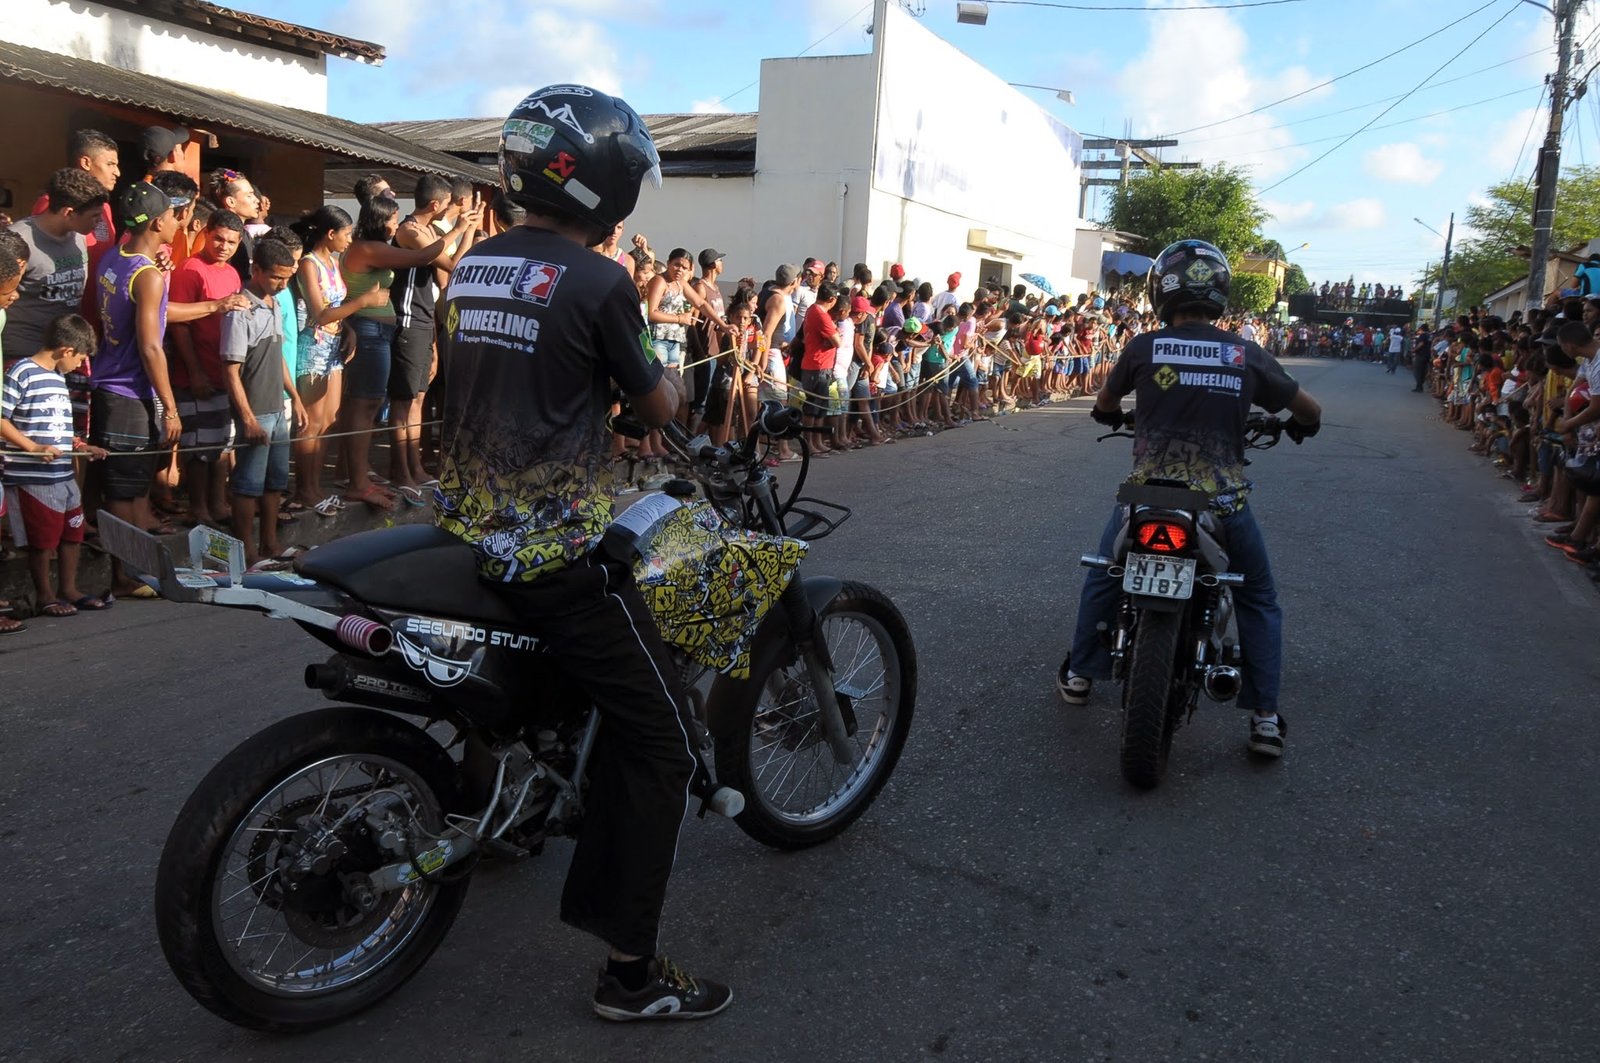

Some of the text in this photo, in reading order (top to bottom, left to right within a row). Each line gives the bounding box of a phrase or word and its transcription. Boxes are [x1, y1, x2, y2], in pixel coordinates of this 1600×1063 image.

[450, 265, 518, 287] PRATIQUE
[460, 309, 540, 342] WHEELING
[1154, 343, 1220, 360] PRATIQUE
[1178, 371, 1243, 392] WHEELING
[1136, 560, 1184, 580] NPY
[1132, 576, 1184, 596] 9187
[406, 618, 540, 652] SEGUNDO STUNT
